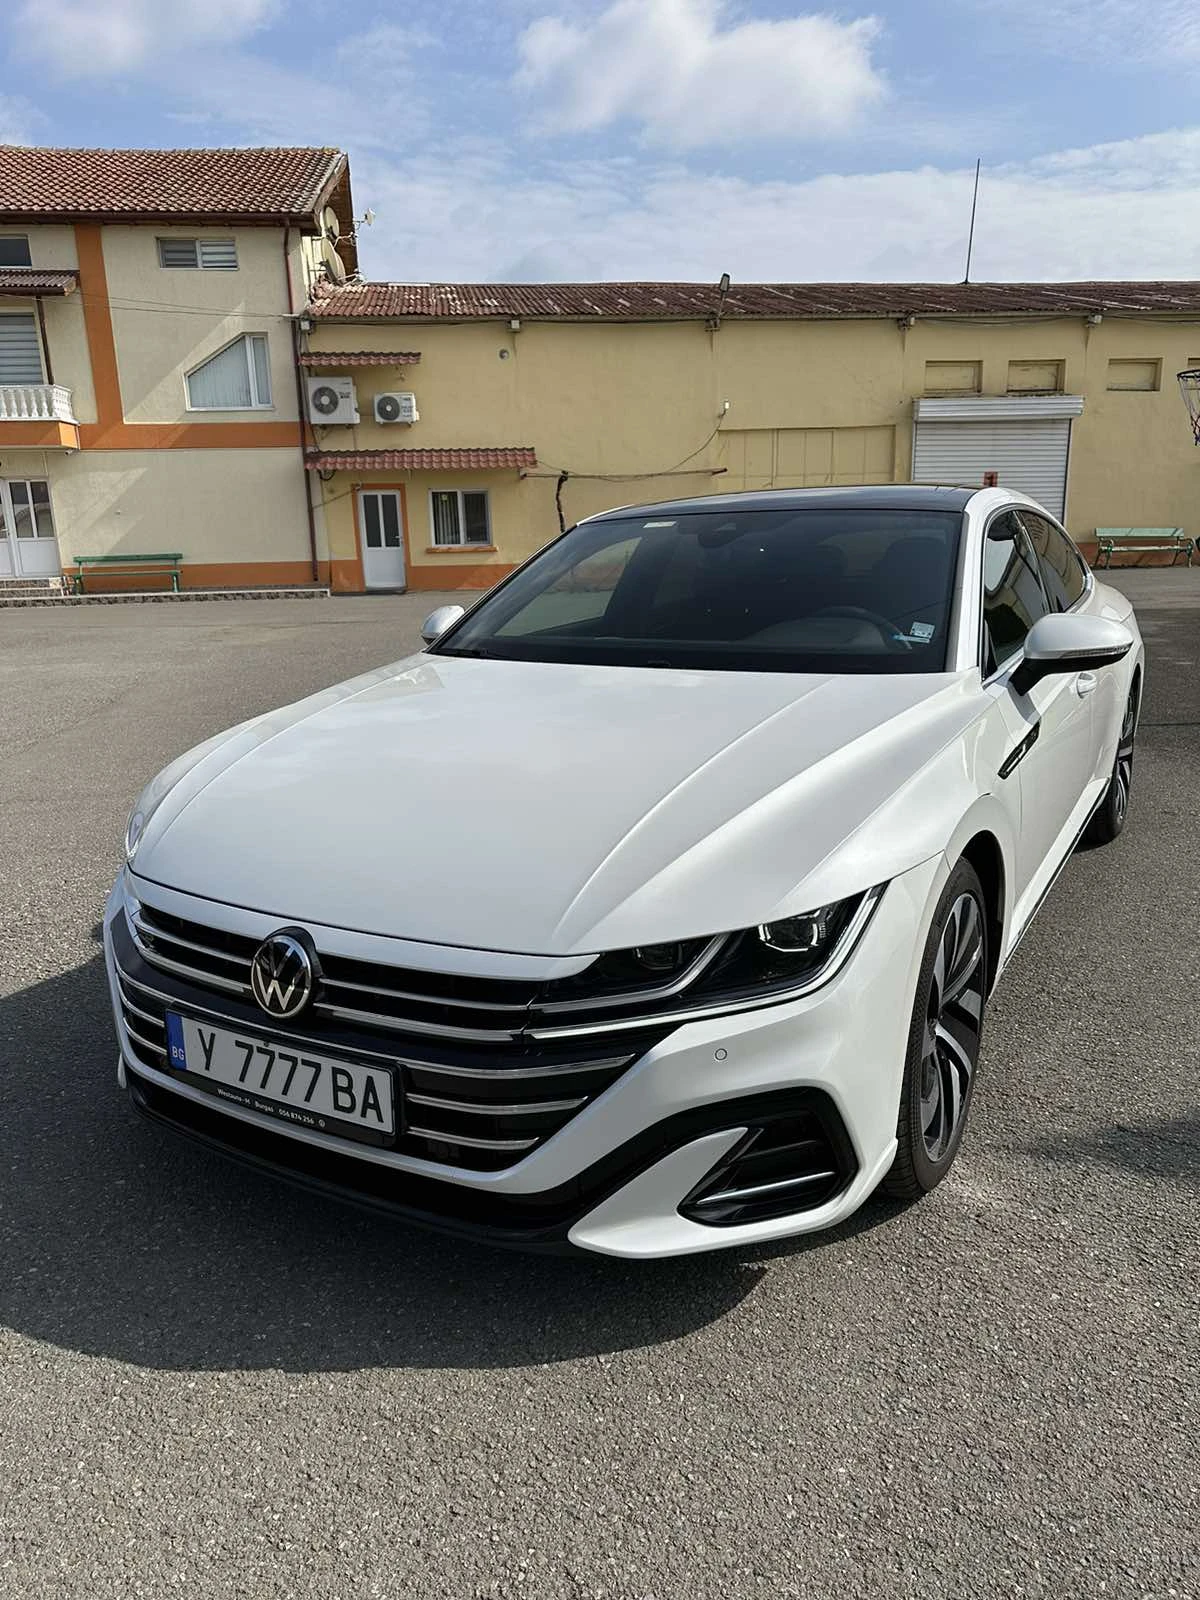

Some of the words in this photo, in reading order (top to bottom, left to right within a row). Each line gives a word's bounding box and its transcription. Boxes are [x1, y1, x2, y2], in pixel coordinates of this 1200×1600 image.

[171, 1046, 185, 1061] BG
[197, 1028, 216, 1071] Y
[235, 1039, 322, 1103] 7777
[331, 1066, 384, 1124] BA
[255, 1101, 274, 1113] Burgas
